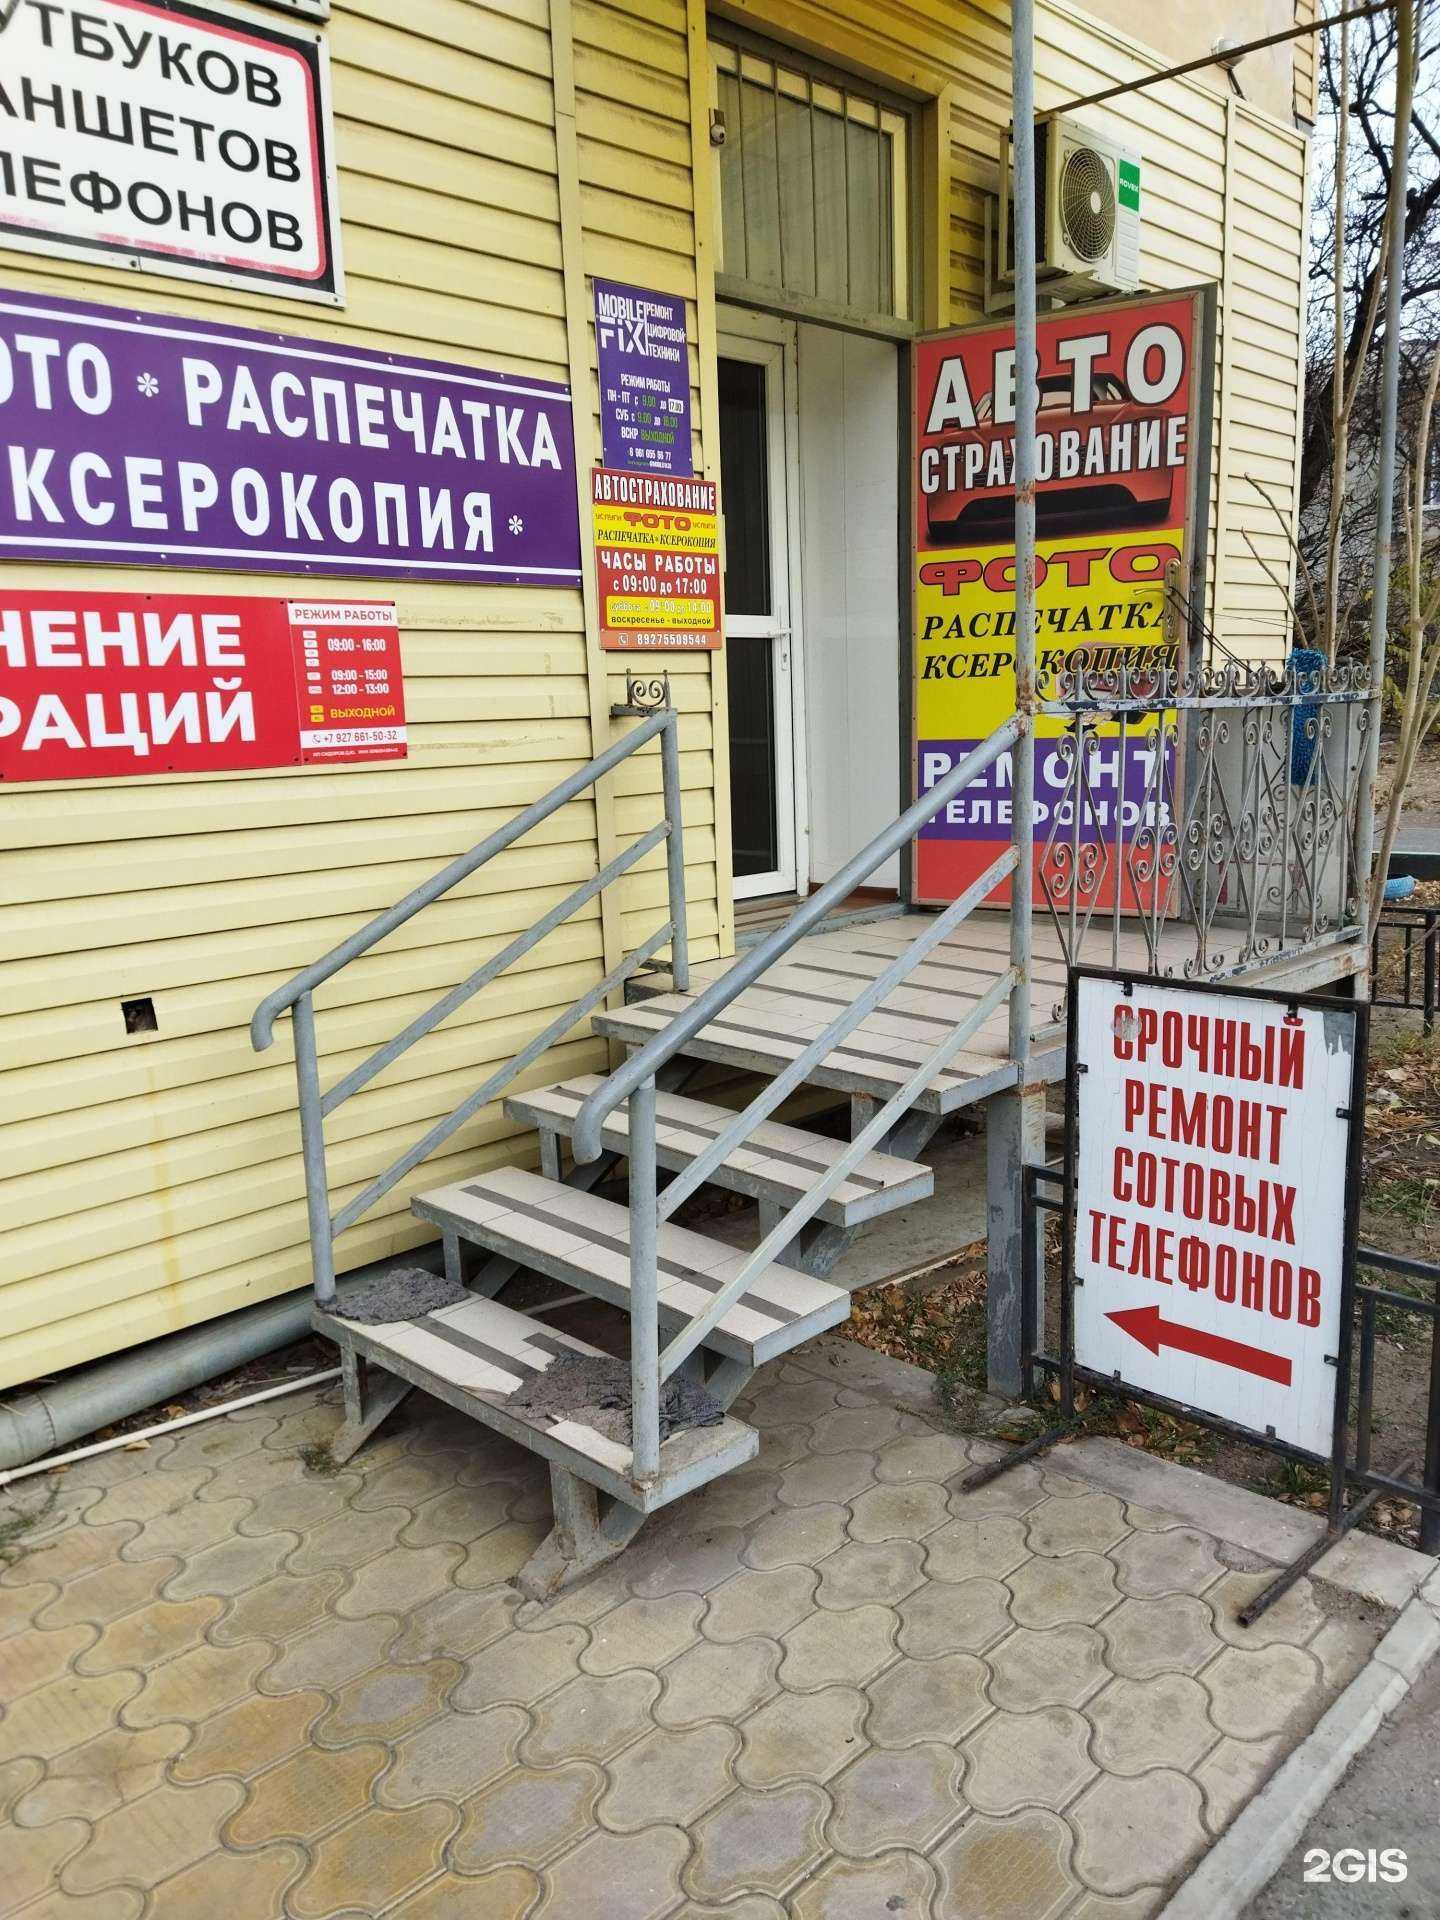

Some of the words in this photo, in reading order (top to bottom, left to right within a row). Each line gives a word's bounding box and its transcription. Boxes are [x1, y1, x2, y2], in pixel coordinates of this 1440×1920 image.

[598, 292, 645, 322] MOBILE
[646, 302, 673, 321] РЕМОНТ
[647, 322, 685, 344] ЦИФРОВОЙ
[648, 343, 680, 363] ТЕХНИКИ
[620, 373, 645, 389] РЕЖИМ
[646, 378, 671, 393] РАБОТЫ
[926, 322, 1184, 434] АВТО
[607, 389, 617, 402] ПН
[621, 391, 630, 404] ПТ
[182, 357, 561, 469] РАСПЕЧАТКА
[615, 408, 629, 421] СУБ
[621, 426, 639, 439] ВСКР
[8, 446, 494, 553] КСЕРОКОПИЯ
[595, 474, 715, 511] АВТОСТРАХОВАНИЕ
[623, 511, 691, 531] ФОТО
[597, 529, 654, 545] РАСПЕЧАТКА
[659, 533, 716, 549] КСЕРОКОПИЯ
[601, 551, 646, 571] ЧАСЫ
[655, 554, 715, 575] РАБОТЫ
[919, 543, 1181, 596] ФОТО
[622, 574, 657, 593] 09:00
[660, 582, 672, 595] до
[675, 577, 707, 594] 17:00
[294, 609, 341, 620] РЕЖИМ
[344, 610, 393, 620] РАБОТЫ
[611, 616, 665, 626] воскресенье
[672, 617, 711, 627] выходной
[327, 638, 354, 651] 09:00
[362, 638, 387, 651] 16:00
[921, 644, 1180, 679] КСЕРКОПИЯ
[331, 669, 357, 681] 09:00
[364, 669, 388, 681] 15:00
[332, 683, 358, 695] 12:00
[364, 683, 390, 694] 13:00
[330, 705, 396, 719] ВЫХОДНОЙ
[324, 734, 333, 743] +7
[336, 733, 352, 743] 927
[1113, 1003, 1306, 1090] СРОЧНЫЙ
[1125, 1079, 1287, 1165] РЕМОНТ
[1113, 1147, 1297, 1246] СОТОВЫХ
[1089, 1209, 1321, 1328] ТЕЛЕФОНОВ
